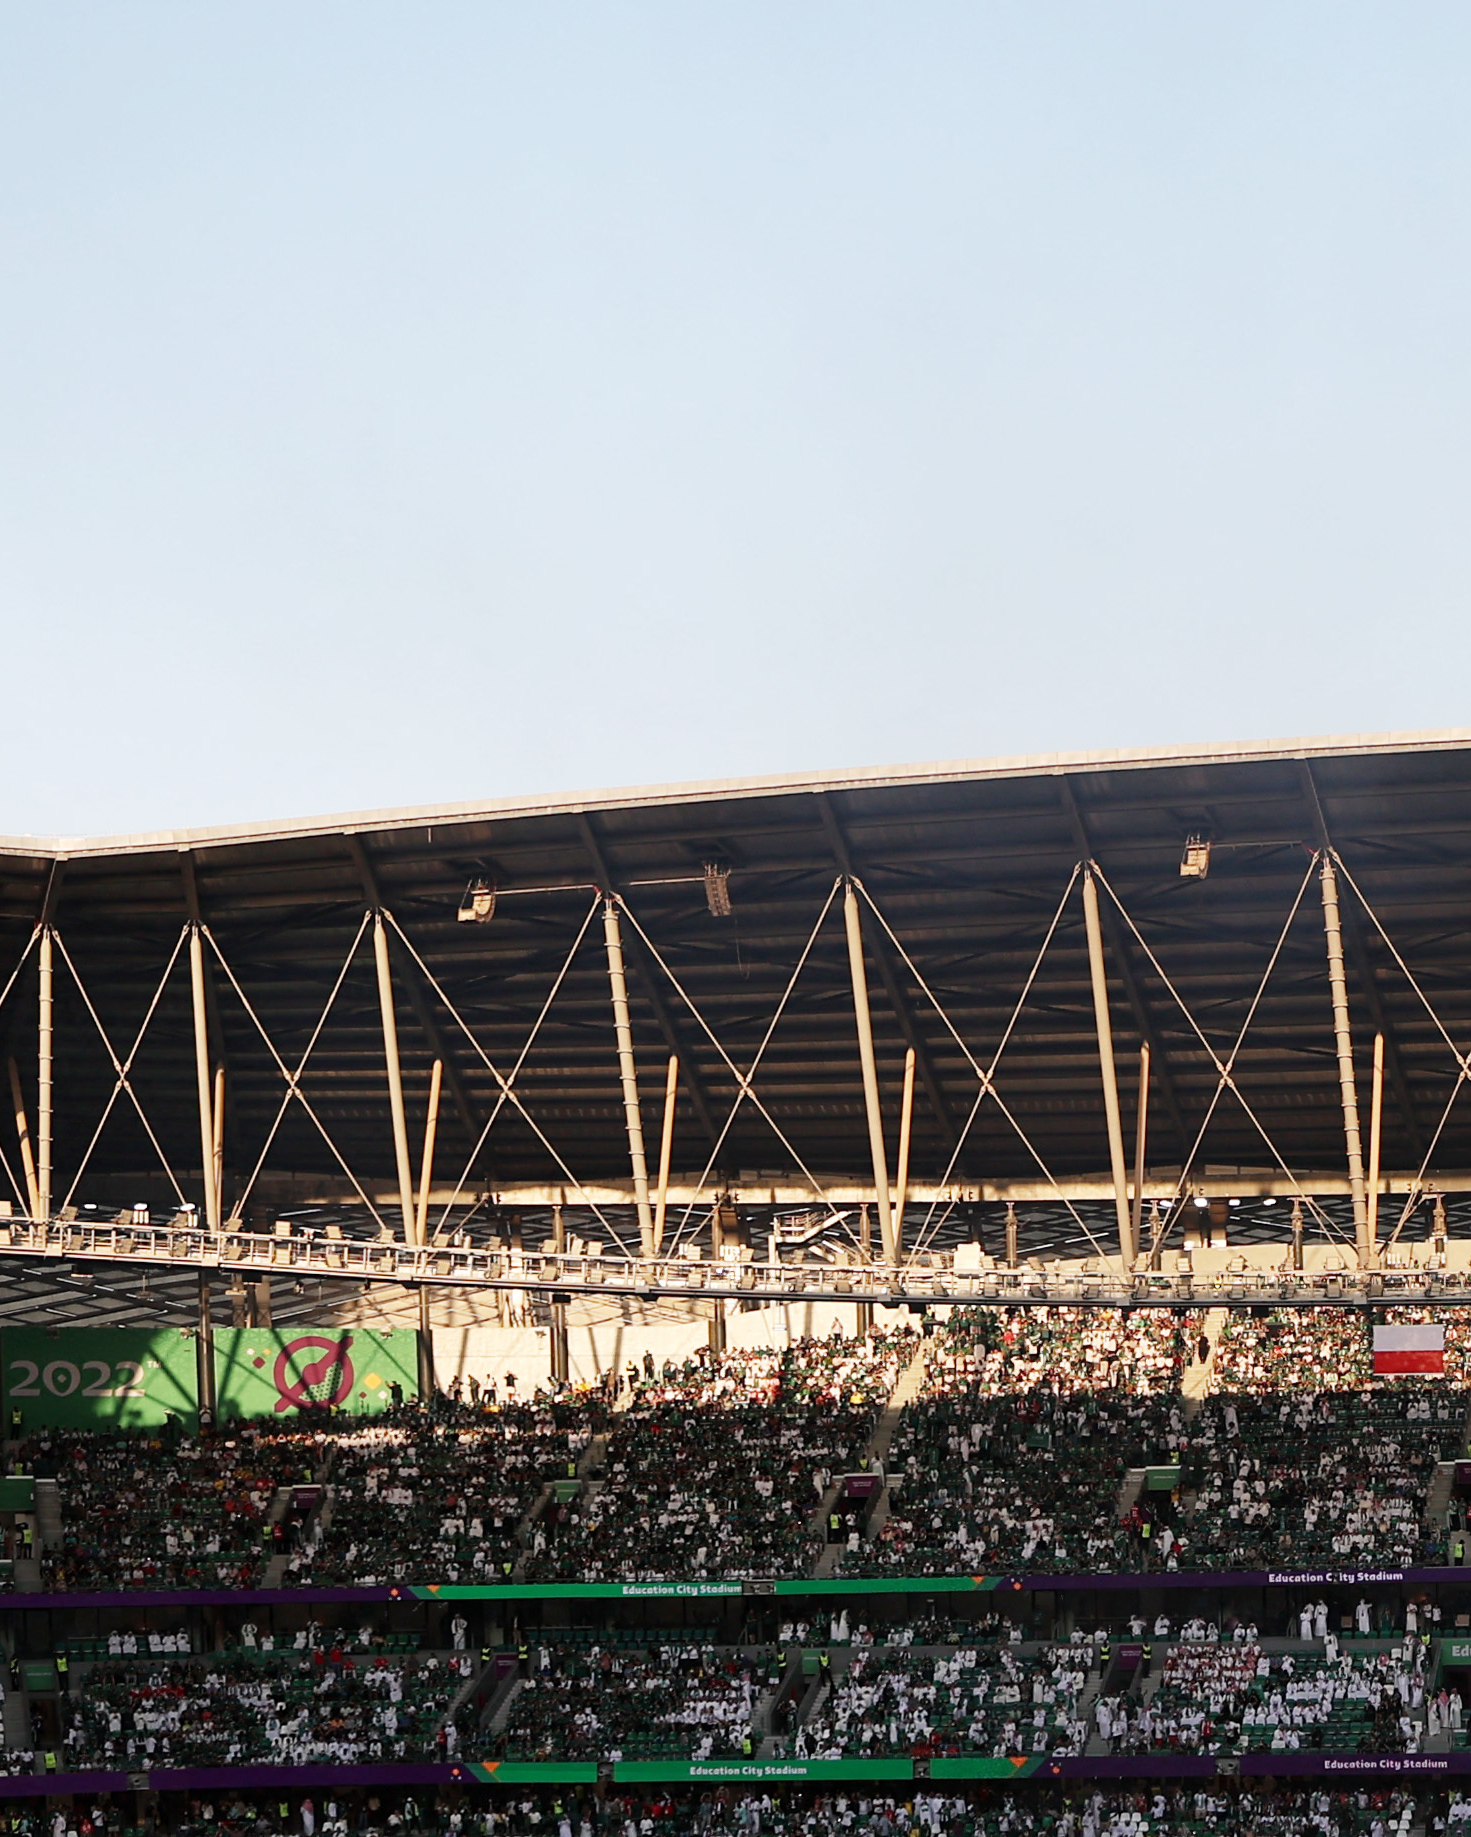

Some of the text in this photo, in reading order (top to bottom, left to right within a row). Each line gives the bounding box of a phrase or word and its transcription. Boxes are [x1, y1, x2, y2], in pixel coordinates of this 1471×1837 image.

[8, 1360, 146, 1398] 2022
[1268, 1573, 1324, 1583] Education
[1357, 1571, 1404, 1581] Stadium
[622, 1584, 742, 1597] Education City Stadium
[1324, 1759, 1448, 1771] Education City Stadium
[690, 1766, 808, 1777] Education City Stadium
